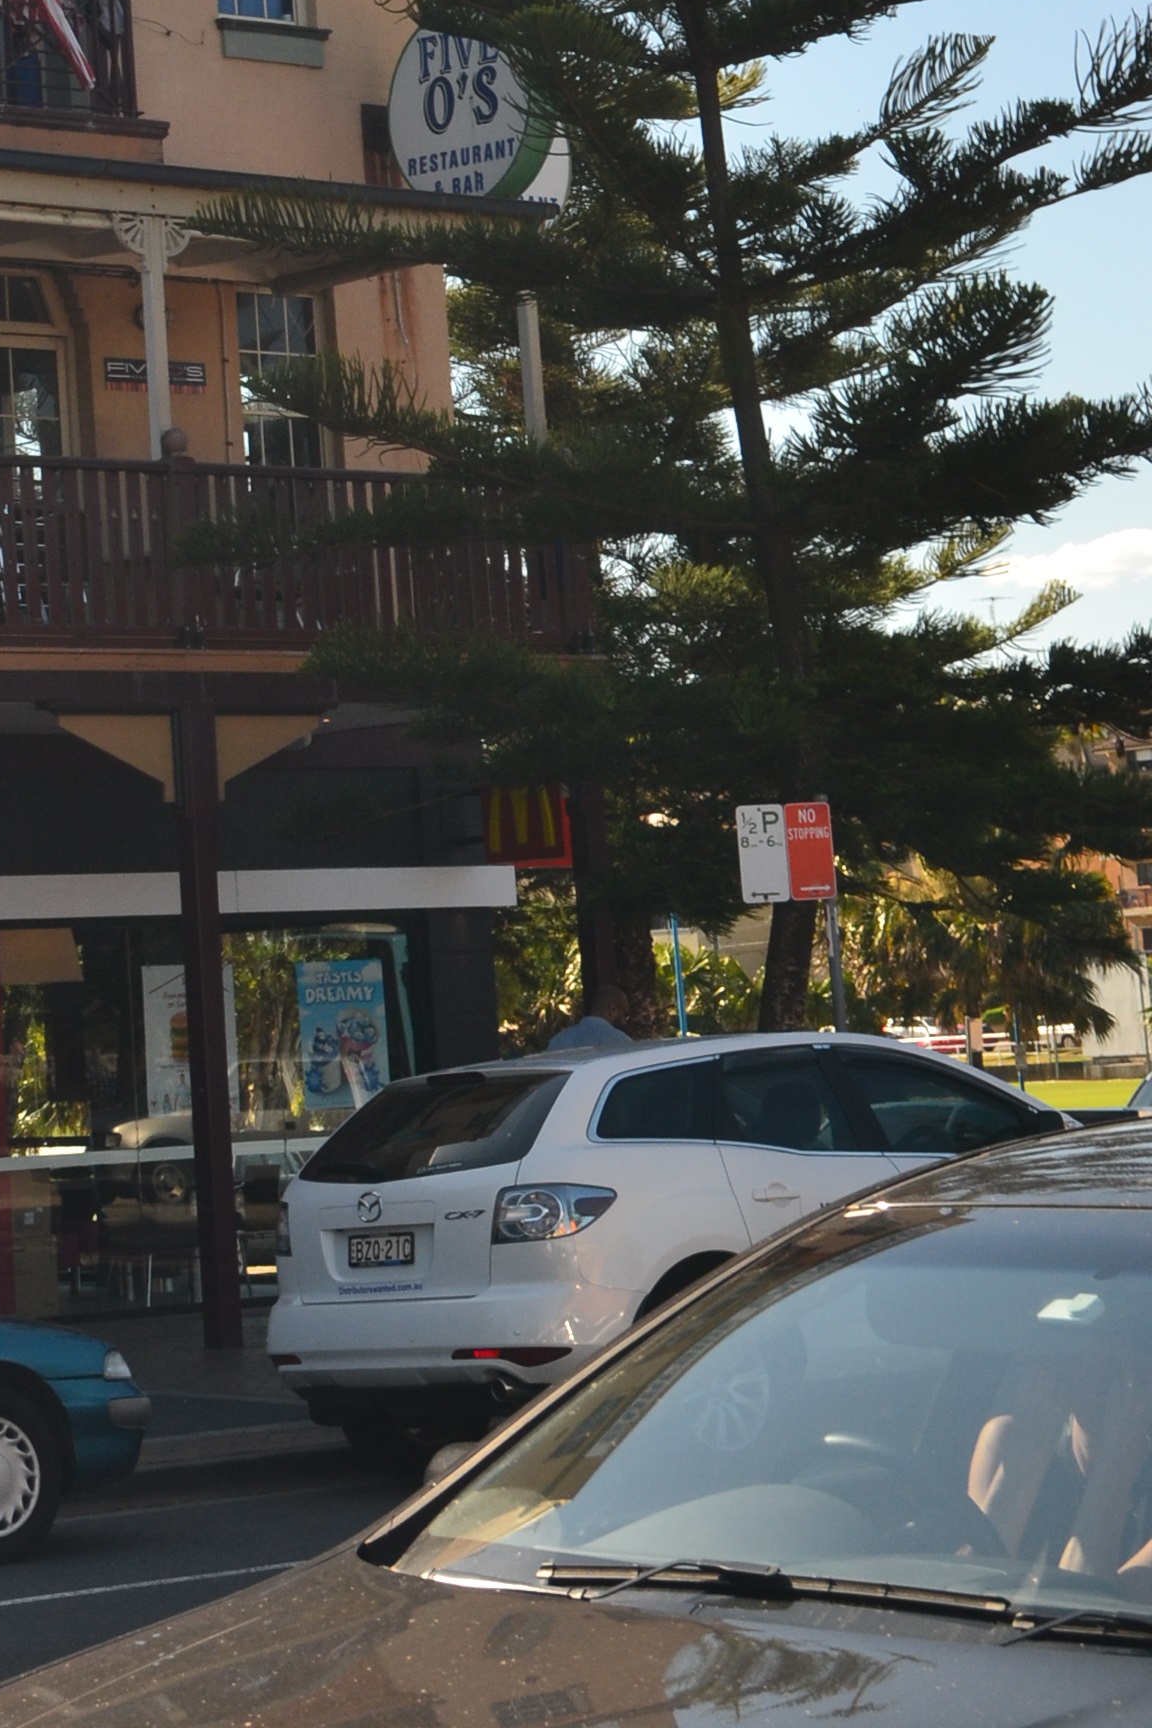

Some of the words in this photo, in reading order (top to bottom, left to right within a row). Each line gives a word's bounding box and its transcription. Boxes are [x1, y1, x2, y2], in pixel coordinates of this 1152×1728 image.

[423, 64, 499, 135] O'S
[407, 137, 516, 177] RESTAURANT
[452, 170, 485, 194] BAR
[106, 361, 147, 374] FIV
[797, 808, 816, 824] NO
[787, 826, 830, 842] STOPPING
[315, 969, 362, 985] TASTES
[304, 985, 375, 1004] DREAMY
[444, 1209, 486, 1220] CX-7
